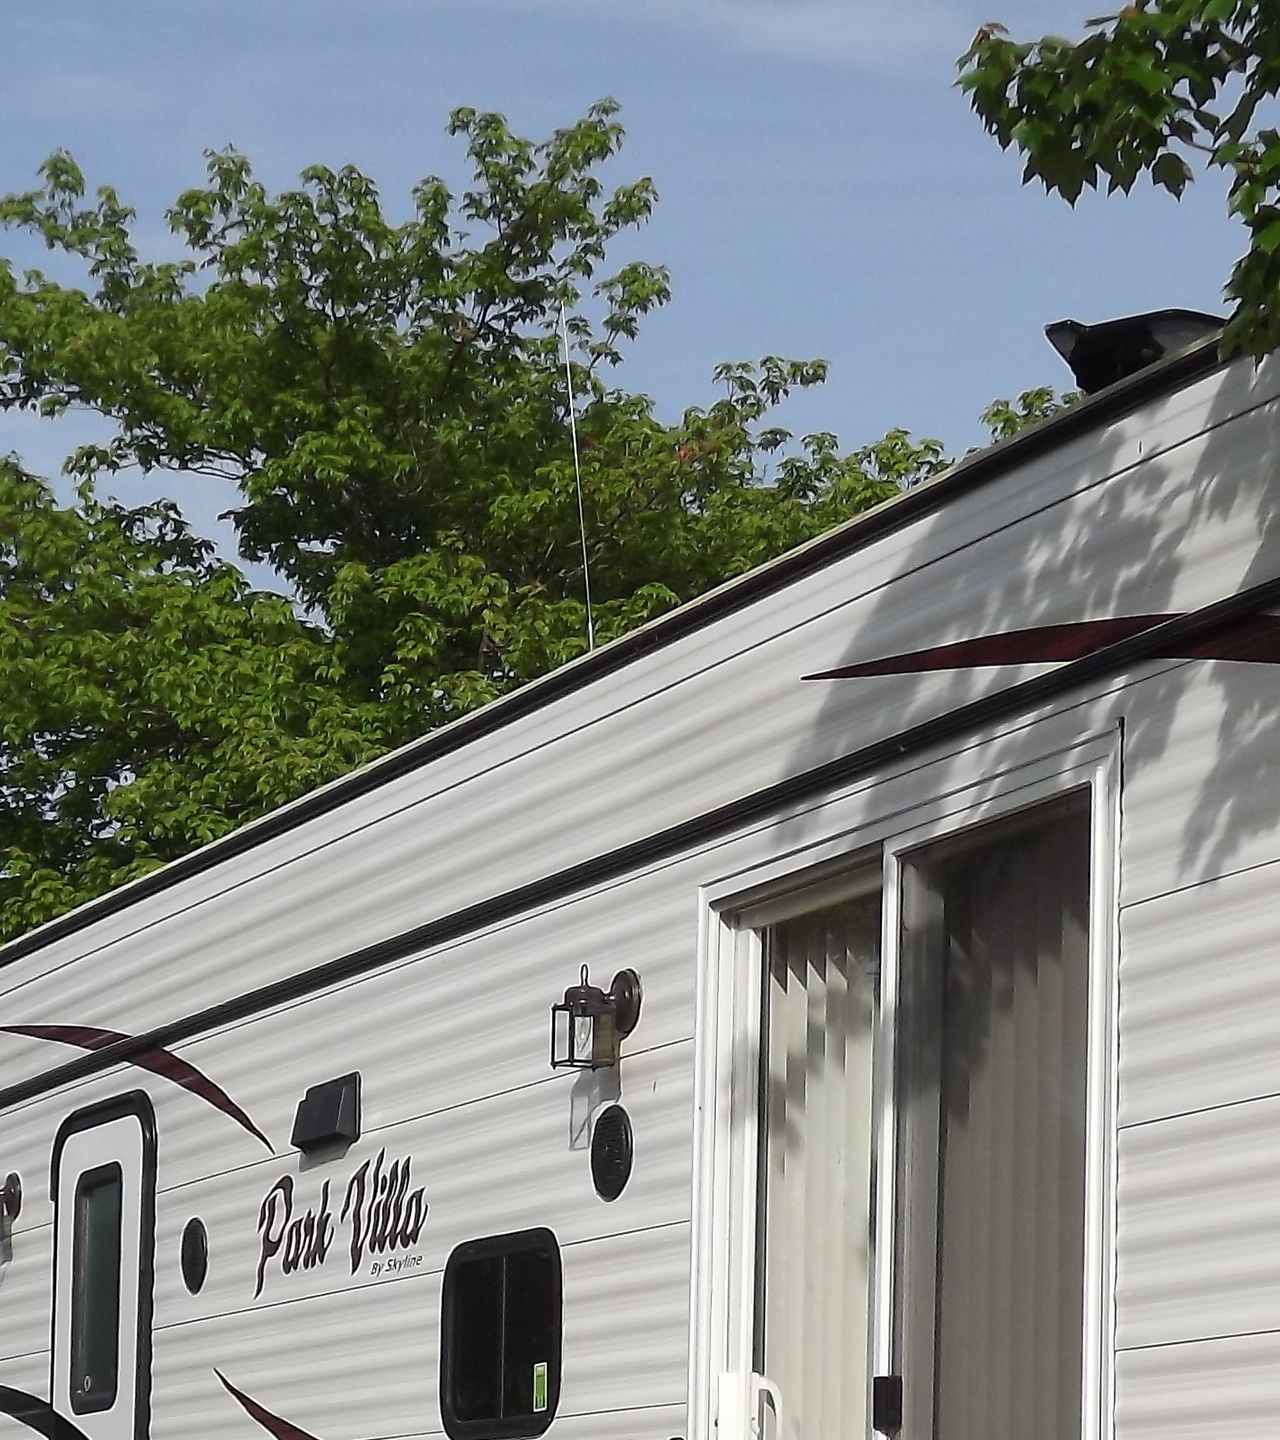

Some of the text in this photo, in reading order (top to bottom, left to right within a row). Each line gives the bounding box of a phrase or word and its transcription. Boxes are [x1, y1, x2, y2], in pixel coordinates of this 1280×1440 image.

[254, 1146, 428, 1300] Park Villa
[385, 1254, 423, 1273] Skyline
